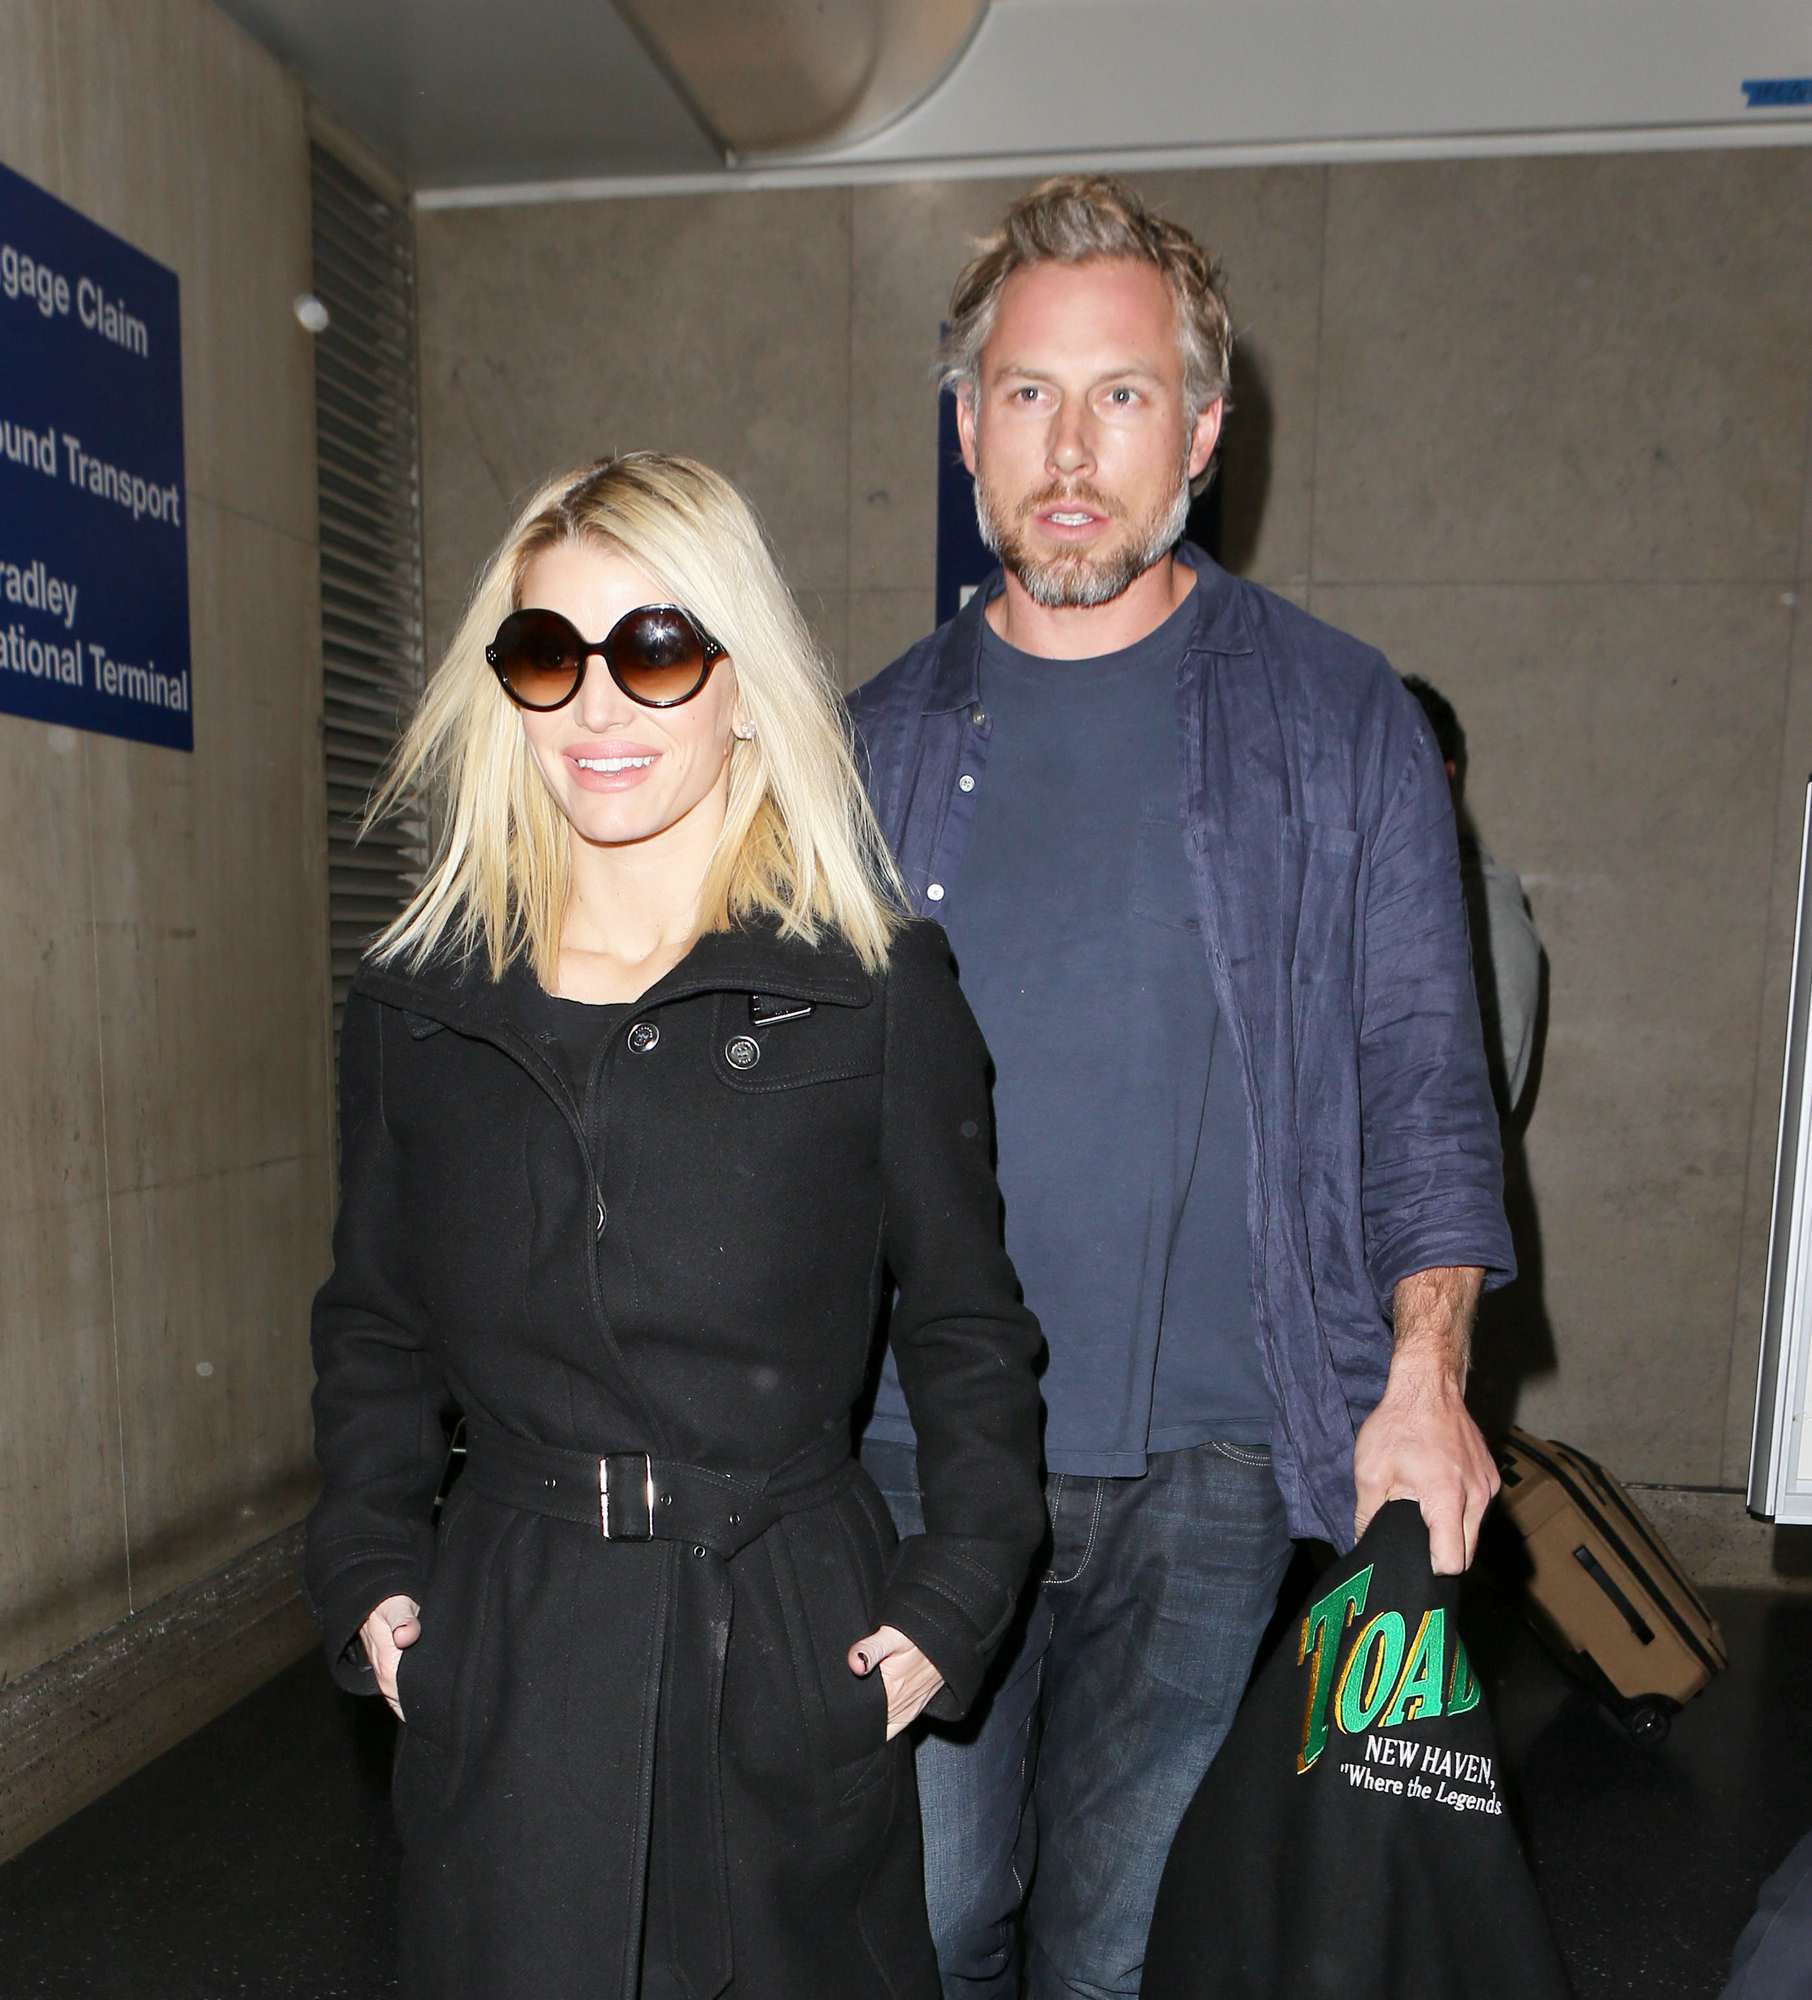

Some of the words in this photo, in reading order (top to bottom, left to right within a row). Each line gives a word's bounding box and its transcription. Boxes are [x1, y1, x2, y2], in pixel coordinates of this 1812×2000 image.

[1, 245, 70, 317] gage
[78, 278, 148, 358] Claim
[63, 434, 180, 527] Transport
[89, 644, 188, 711] Terminal
[1339, 1763, 1404, 1795] "Where
[1407, 1775, 1432, 1800] the
[1435, 1781, 1502, 1816] Legends
[1364, 1734, 1419, 1768] NEW
[1421, 1746, 1496, 1789] HAVEN,
